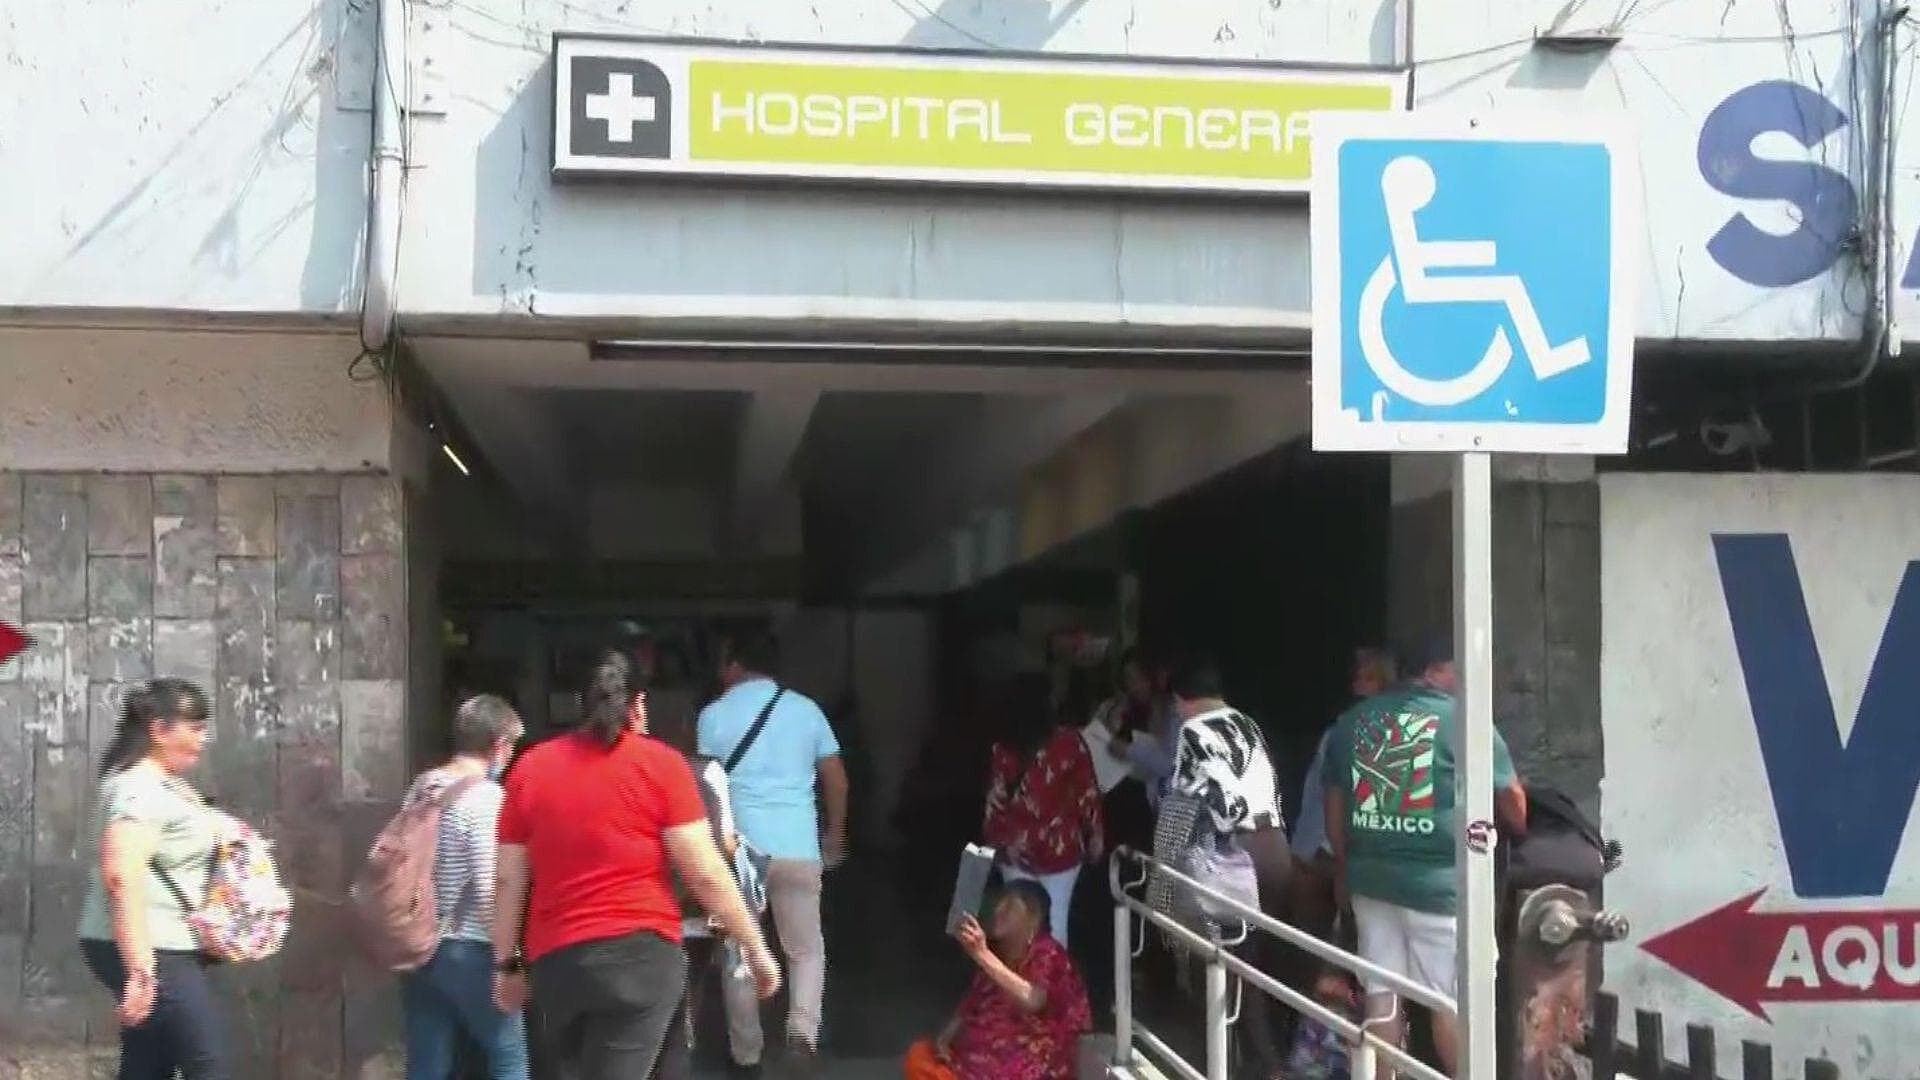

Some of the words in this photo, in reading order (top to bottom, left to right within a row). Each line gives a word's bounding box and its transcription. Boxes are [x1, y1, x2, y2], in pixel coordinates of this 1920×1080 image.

[711, 91, 1032, 142] HOSPITAL
[1065, 102, 1312, 152] GENERA
[1697, 79, 1920, 288] S
